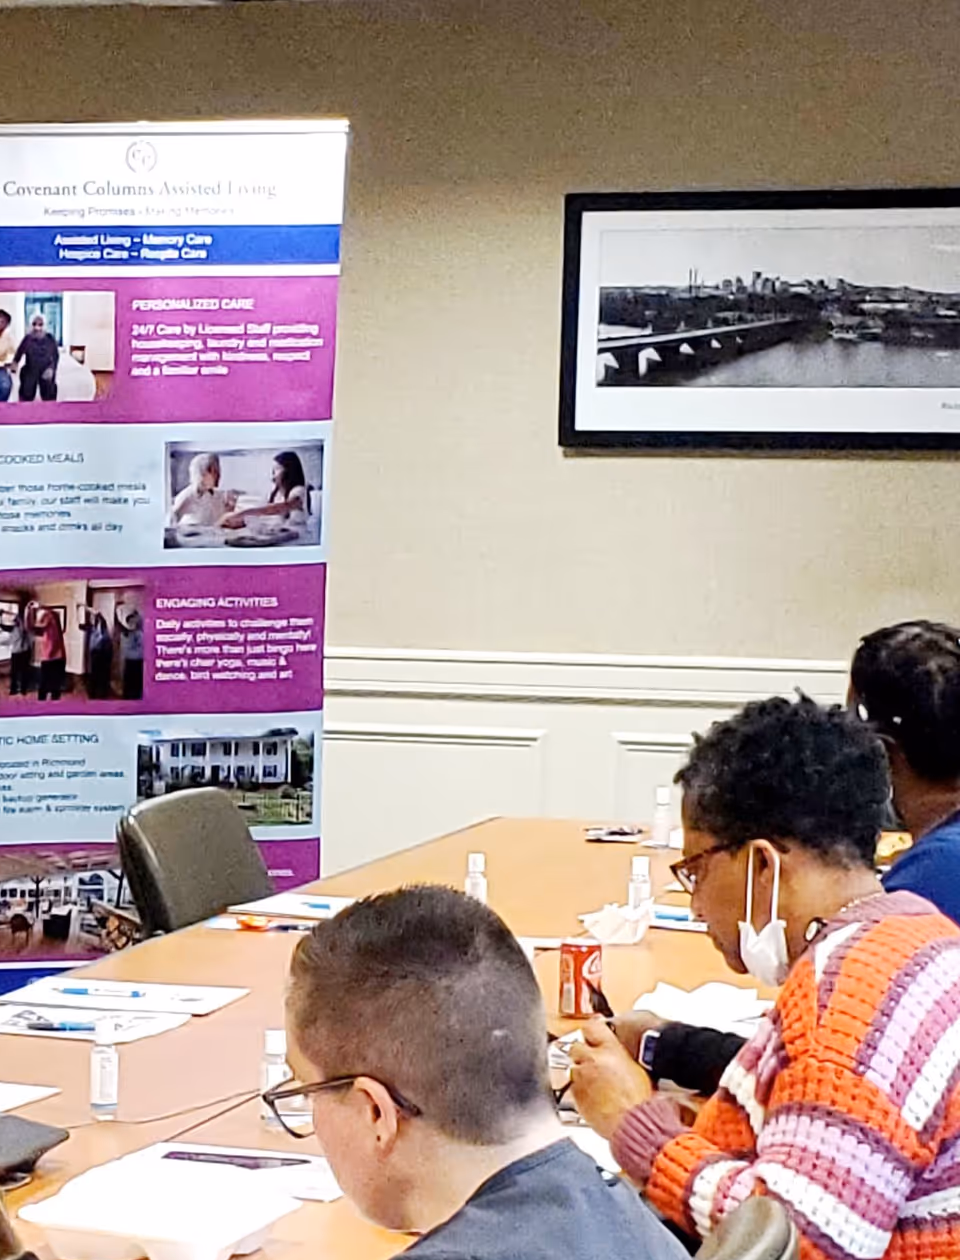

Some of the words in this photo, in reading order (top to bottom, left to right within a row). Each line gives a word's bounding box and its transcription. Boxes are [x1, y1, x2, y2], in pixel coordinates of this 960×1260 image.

[3, 180, 77, 197] Covenant
[83, 180, 154, 196] Columns
[159, 180, 221, 196] Assisted
[44, 207, 85, 218] Keeping
[88, 207, 135, 217] Promises
[186, 234, 213, 245] Care
[131, 298, 219, 310] PERSONALIZED
[221, 298, 255, 310] CARE
[47, 453, 84, 463] MEALS
[156, 597, 215, 609] ENGAGING
[217, 596, 278, 607] ACTIVITIES
[17, 735, 48, 745] HOME
[51, 734, 99, 744] SETTING
